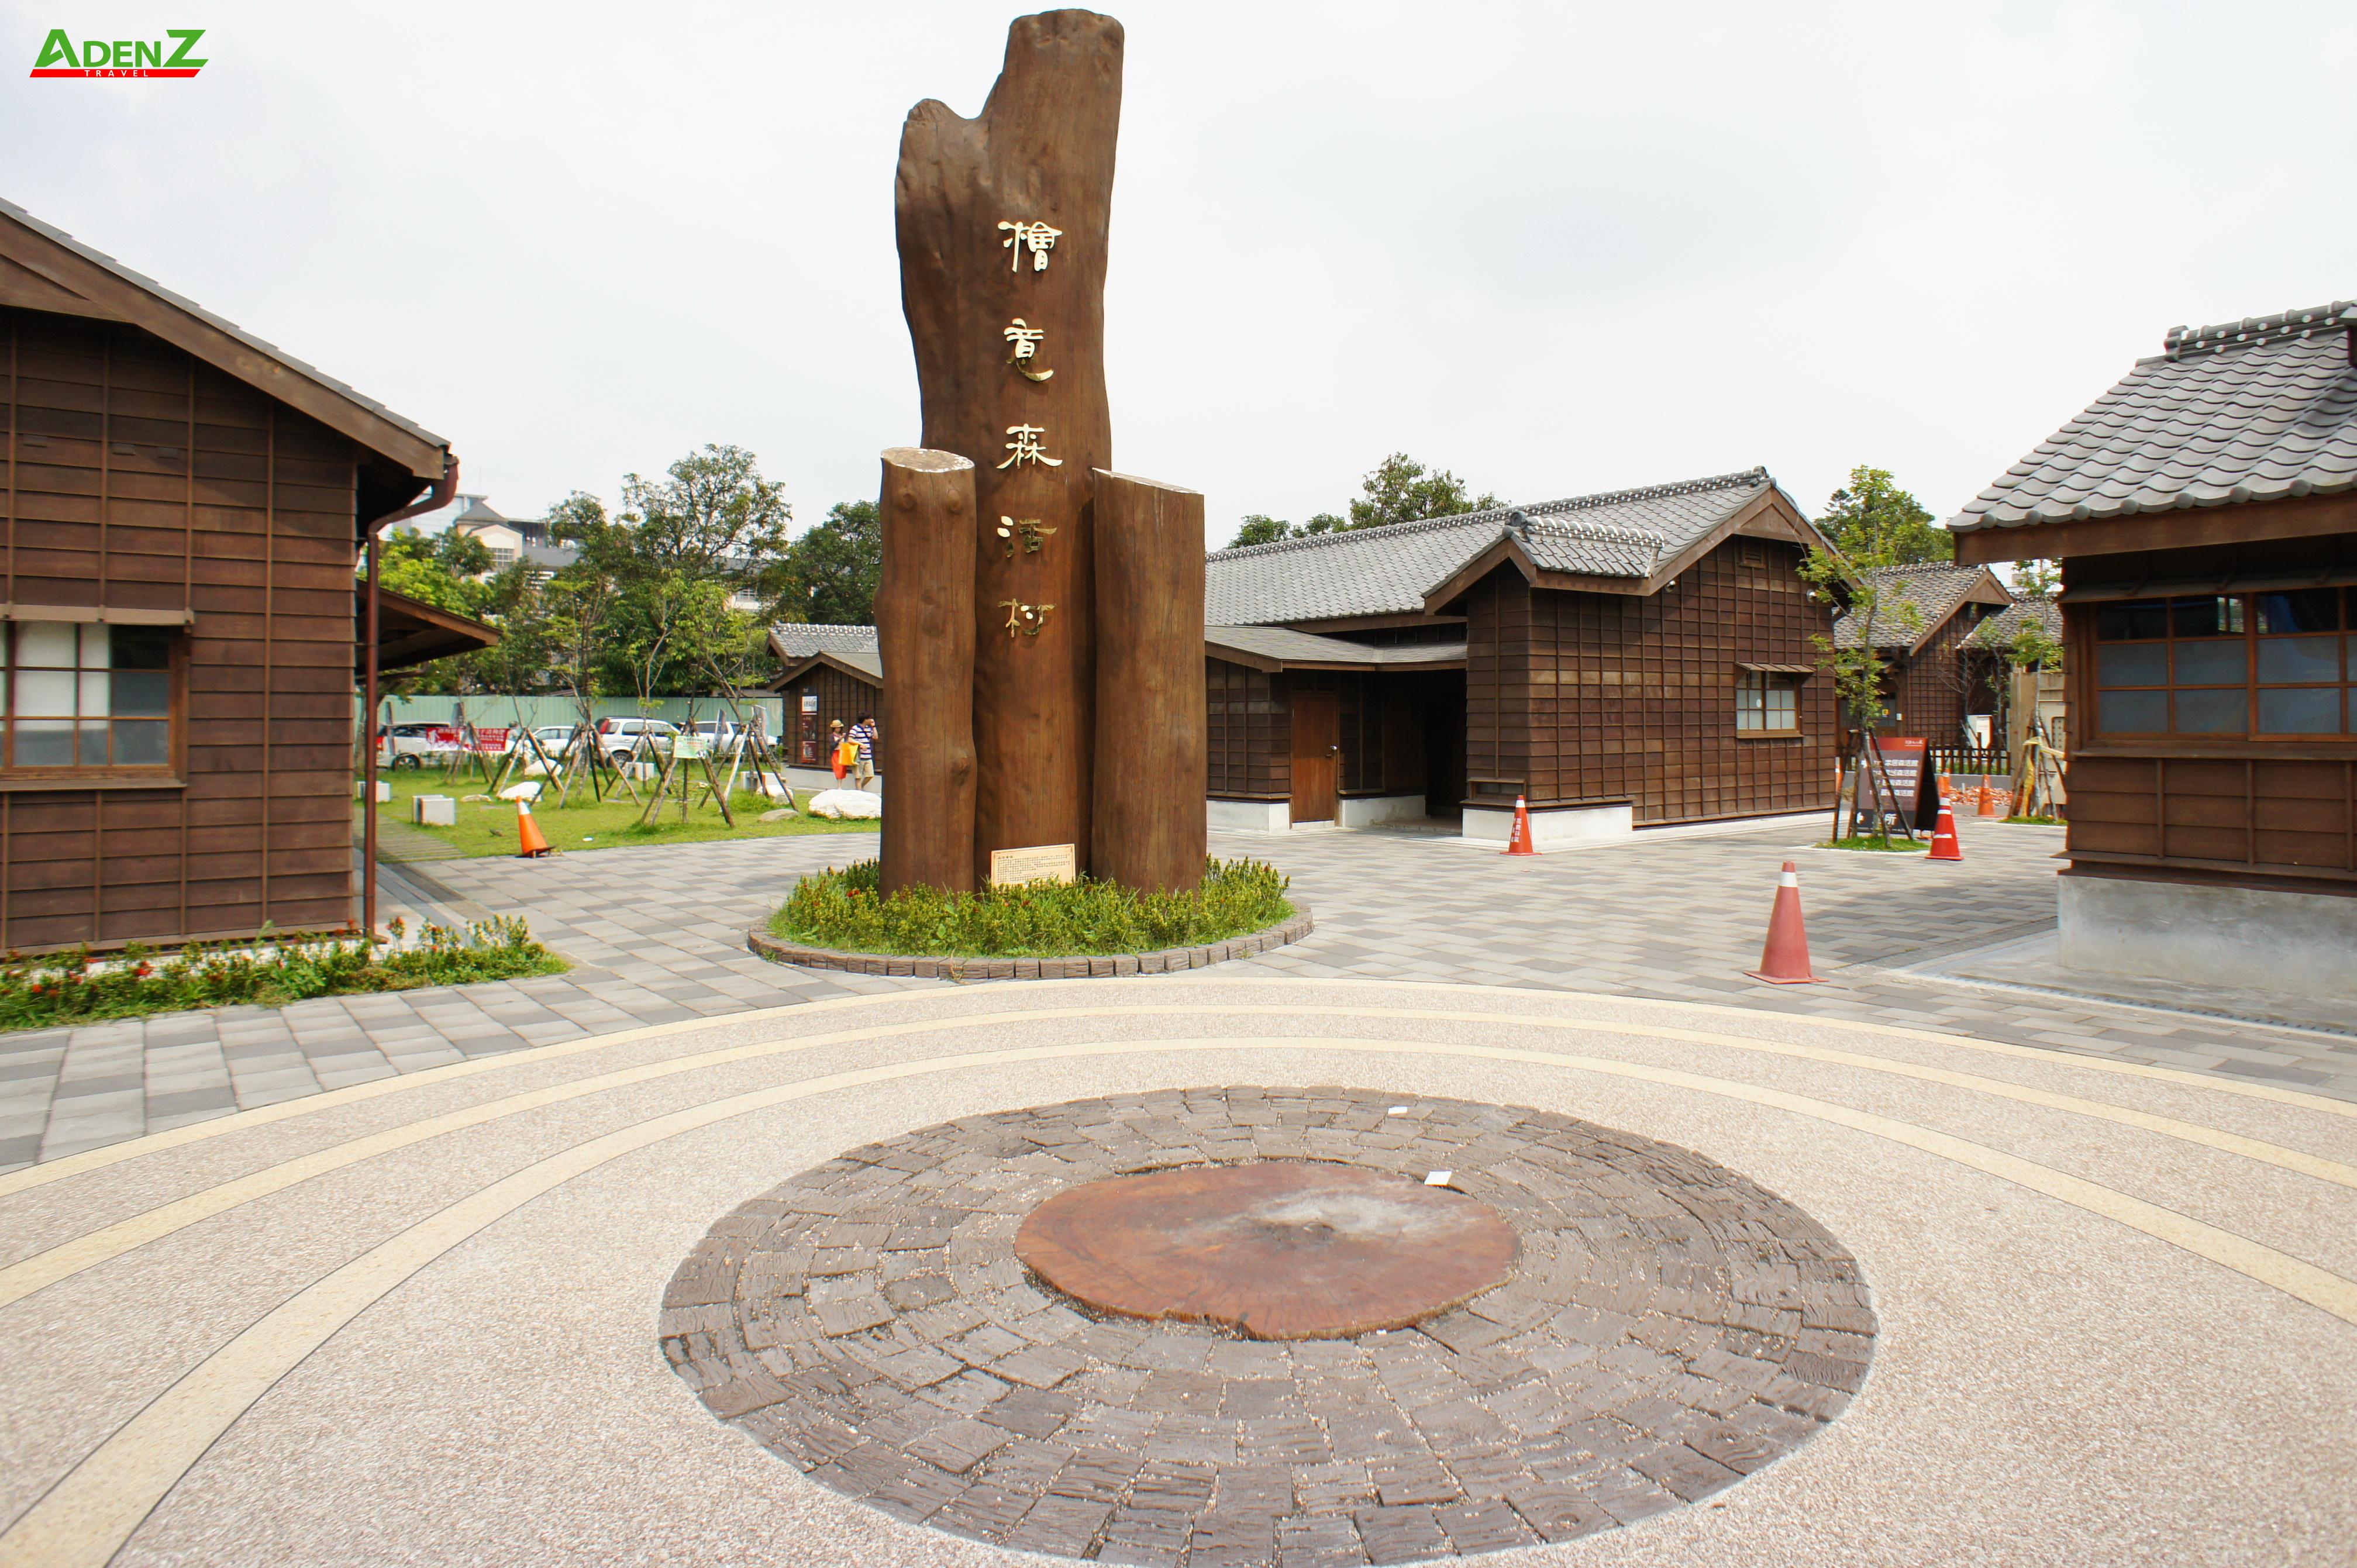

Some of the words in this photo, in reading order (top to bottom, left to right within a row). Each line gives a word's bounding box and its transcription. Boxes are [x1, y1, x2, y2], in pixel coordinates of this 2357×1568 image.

[997, 220, 1063, 639] 檜意森活村
